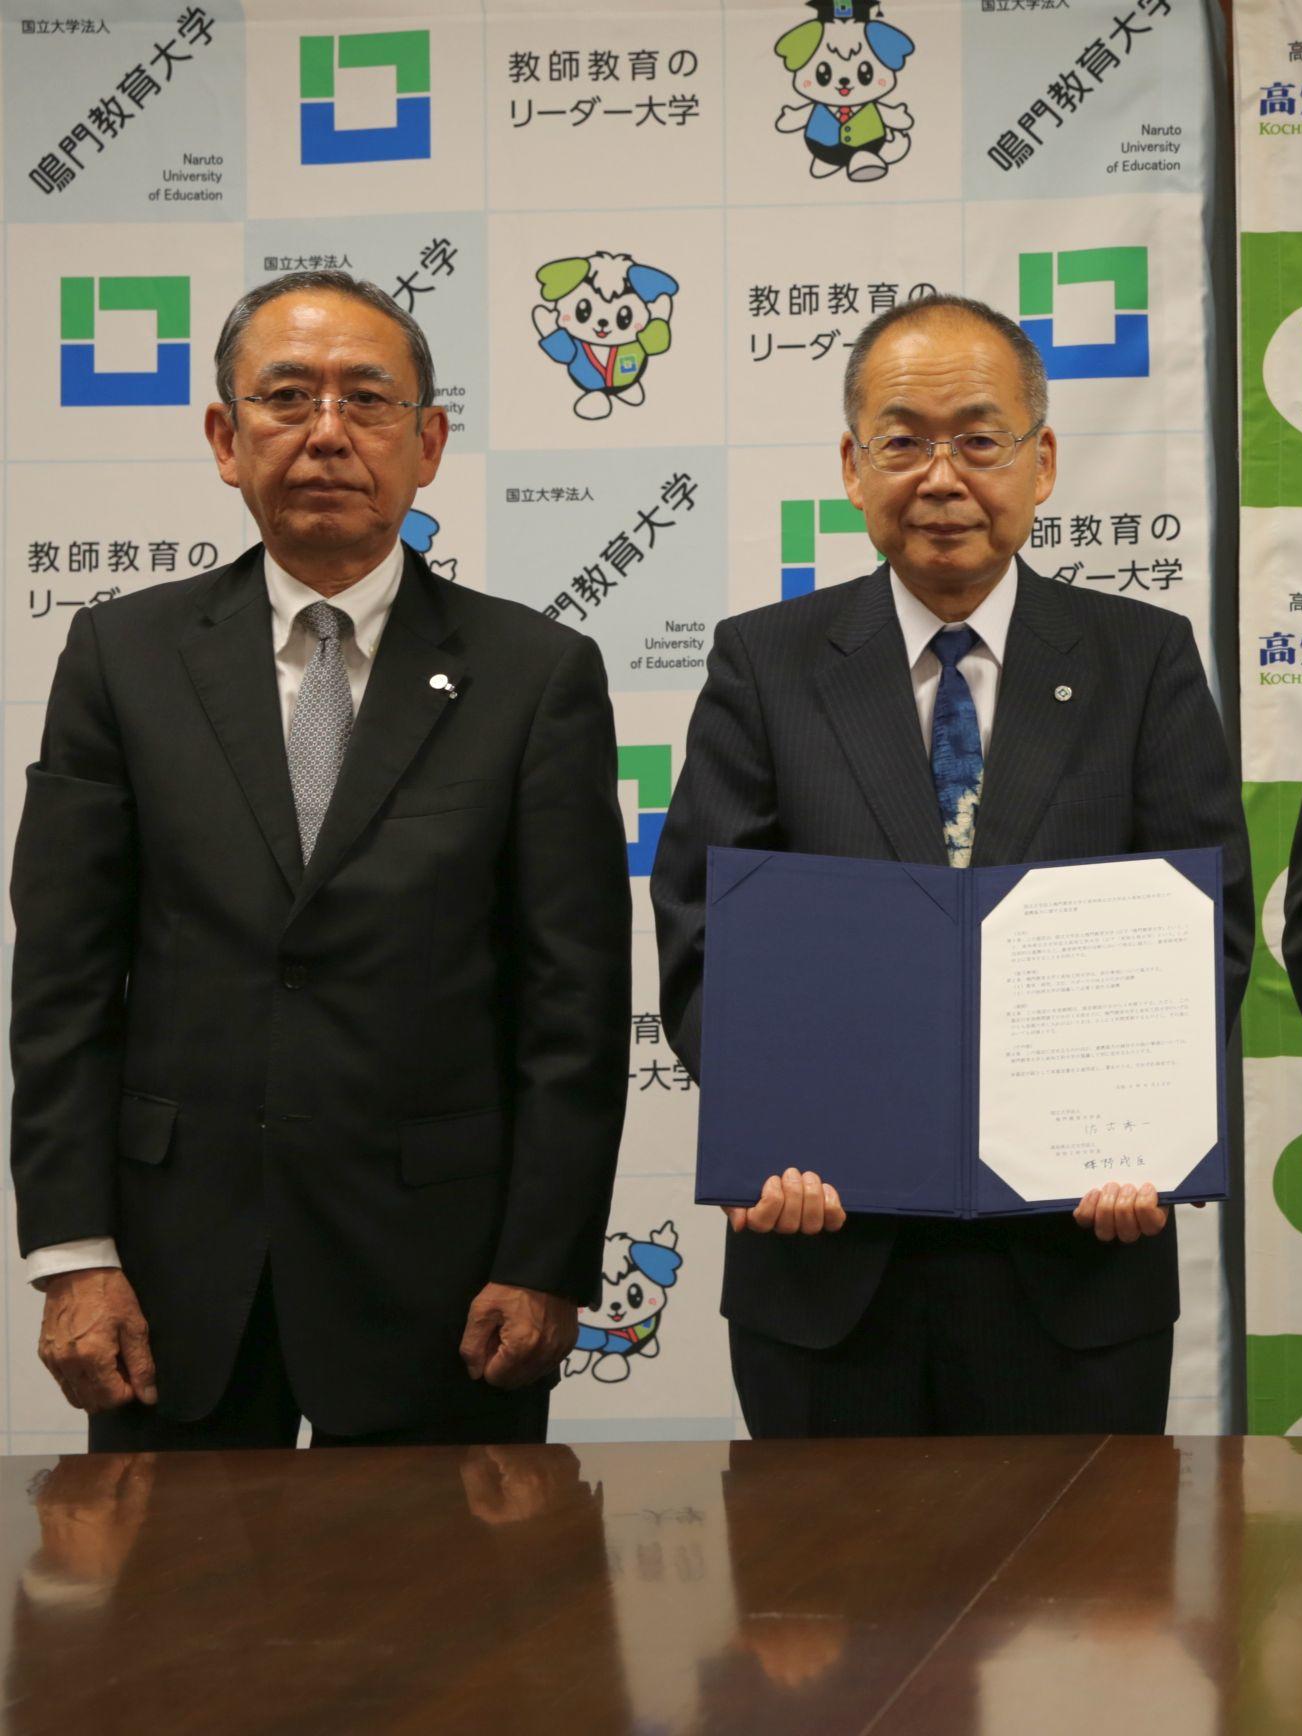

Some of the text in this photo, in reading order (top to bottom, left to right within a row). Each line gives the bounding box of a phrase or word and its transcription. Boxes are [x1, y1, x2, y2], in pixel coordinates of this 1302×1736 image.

[22, 19, 110, 34] 国立大学法人
[509, 49, 698, 83] 教師教育の
[29, 6, 215, 195] 鳴門教育大学
[510, 94, 699, 128] リーダー大学
[1142, 124, 1182, 136] Naruto
[1121, 142, 1180, 154] University
[183, 153, 223, 166] Naruto
[1107, 160, 1180, 173] of Education
[163, 170, 222, 184] University
[148, 188, 223, 201] of Education
[264, 254, 352, 271] 国立大学法人
[749, 282, 938, 317] 教師教育の
[434, 386, 466, 397] aruto
[506, 487, 594, 502] 国立大学法人
[1031, 513, 1181, 549] 師教育の
[28, 540, 218, 573] 教師教育の
[665, 621, 705, 632] Naruto
[645, 638, 704, 650] University
[630, 657, 704, 669] of Education
[629, 1059, 694, 1091] 大学
